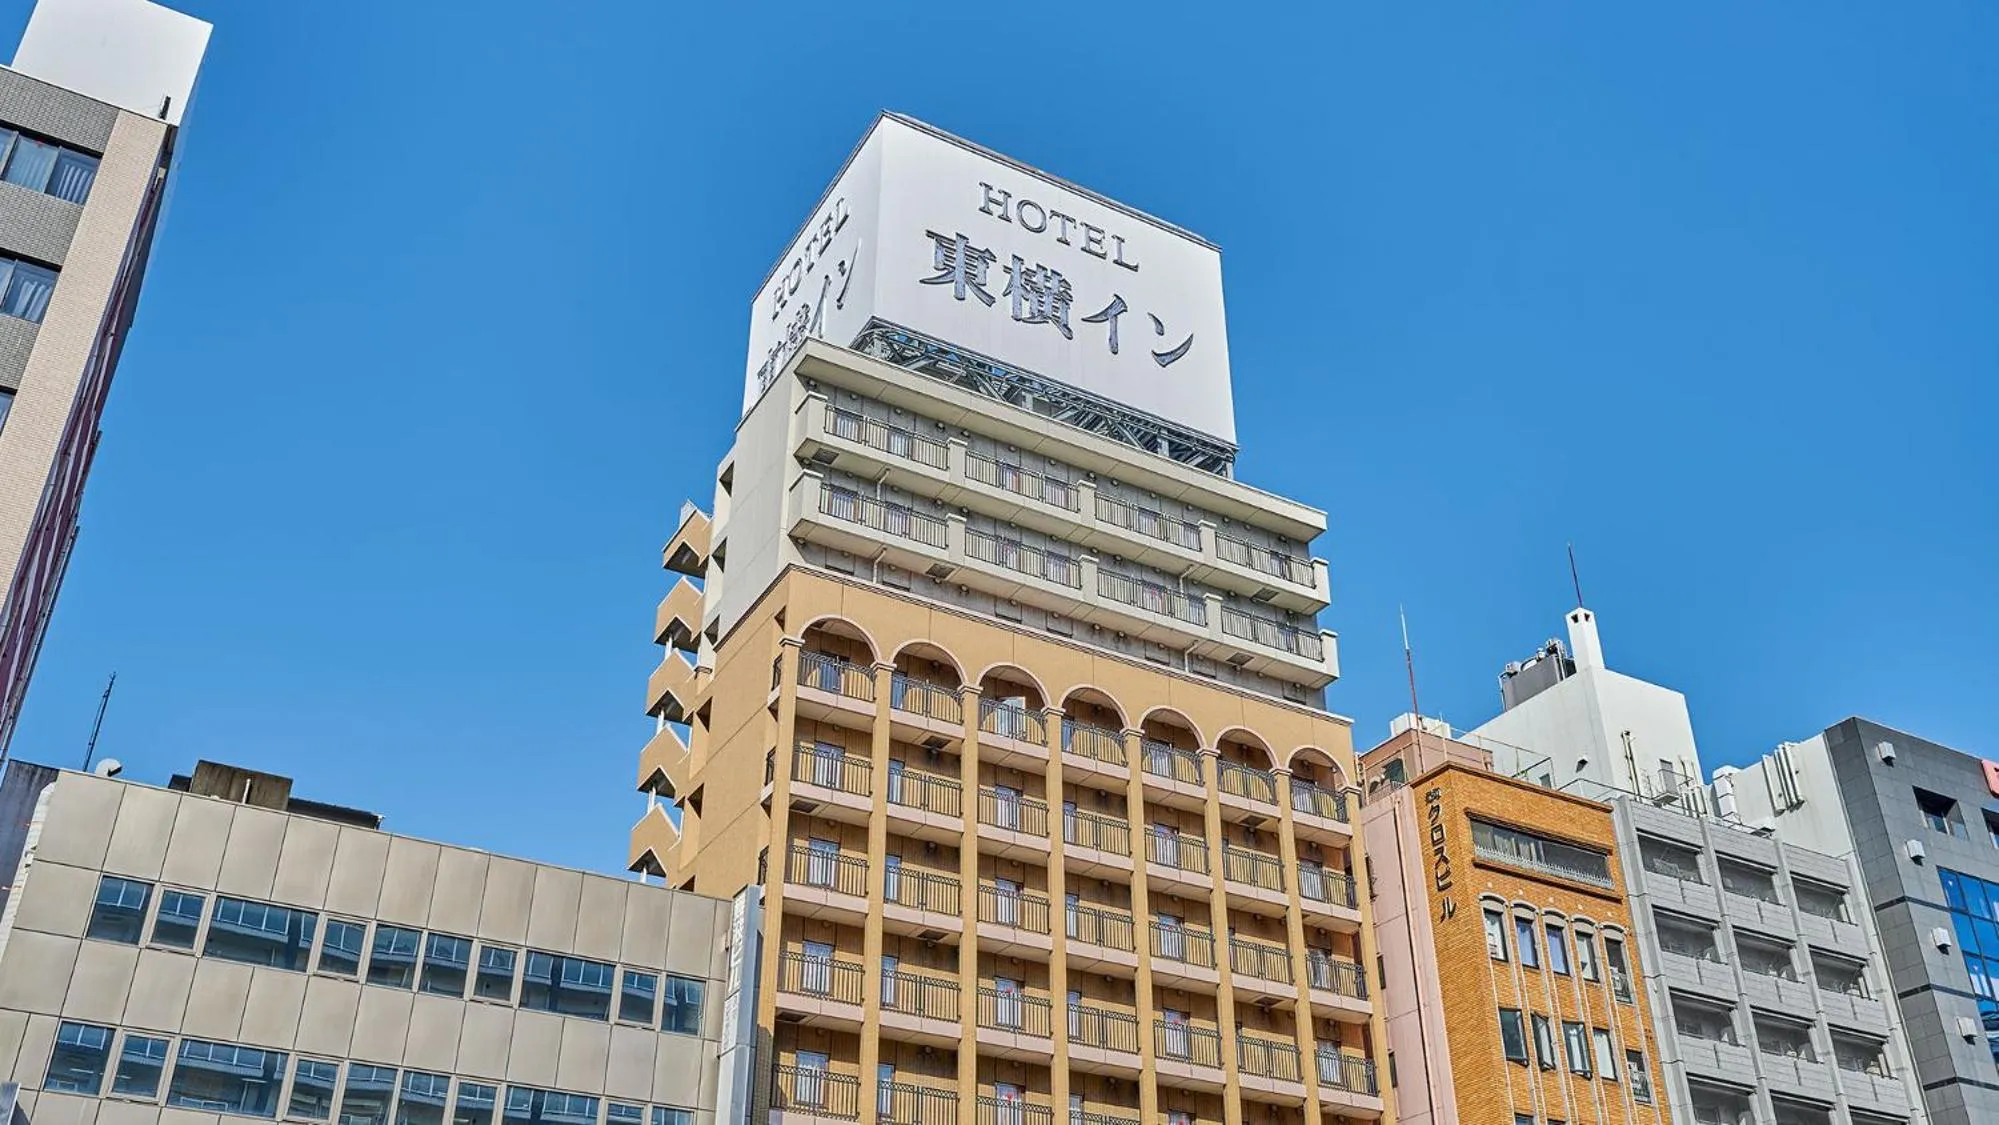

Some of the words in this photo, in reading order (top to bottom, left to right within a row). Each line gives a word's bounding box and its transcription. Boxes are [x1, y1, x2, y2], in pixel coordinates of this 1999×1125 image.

[772, 197, 849, 322] HOTEL
[978, 182, 1140, 272] HOTEL
[919, 228, 1194, 368] 東横イン
